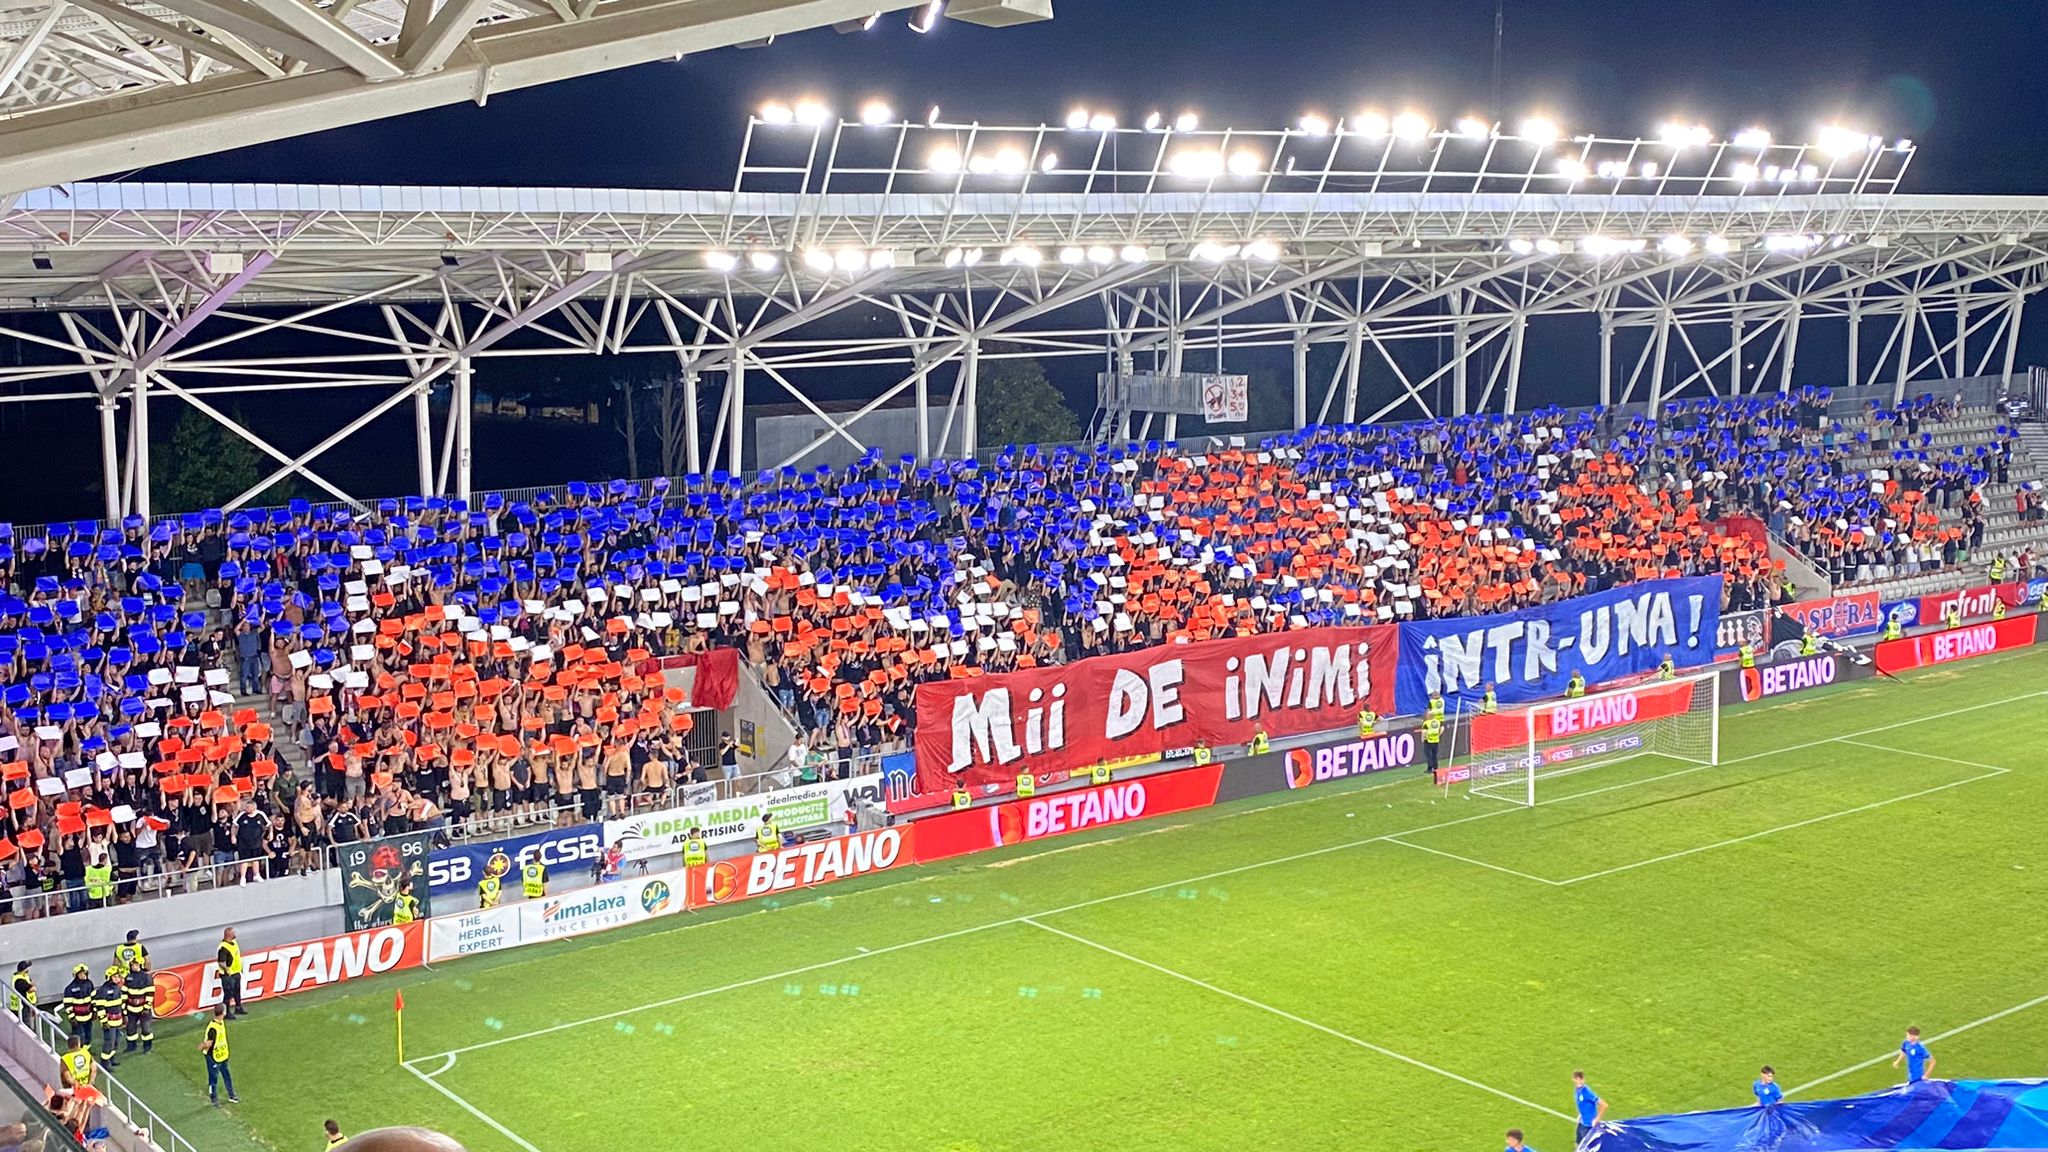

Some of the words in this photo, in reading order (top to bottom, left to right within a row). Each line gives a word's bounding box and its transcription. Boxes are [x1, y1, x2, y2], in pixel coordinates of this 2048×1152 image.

[1934, 625, 1997, 662] BETANO
[1762, 656, 1836, 695] BETANO
[1105, 658, 1186, 741] DE
[1552, 693, 1638, 735] BETANO
[1315, 733, 1415, 781] BETANO
[655, 817, 702, 837] IDEAL
[707, 804, 760, 829] MEDIA
[1027, 783, 1146, 838] BETANO
[671, 823, 745, 845] ADVRTISING
[349, 850, 366, 867] 19
[401, 841, 423, 857] 96
[747, 829, 901, 895] BETANO
[459, 915, 481, 928] THE
[543, 894, 626, 923] Himalaya
[544, 920, 587, 936] SINCE
[596, 912, 628, 927] 1930
[458, 923, 505, 941] HERBAL
[458, 936, 504, 954] EXPERT
[197, 926, 405, 1009] BETANO
